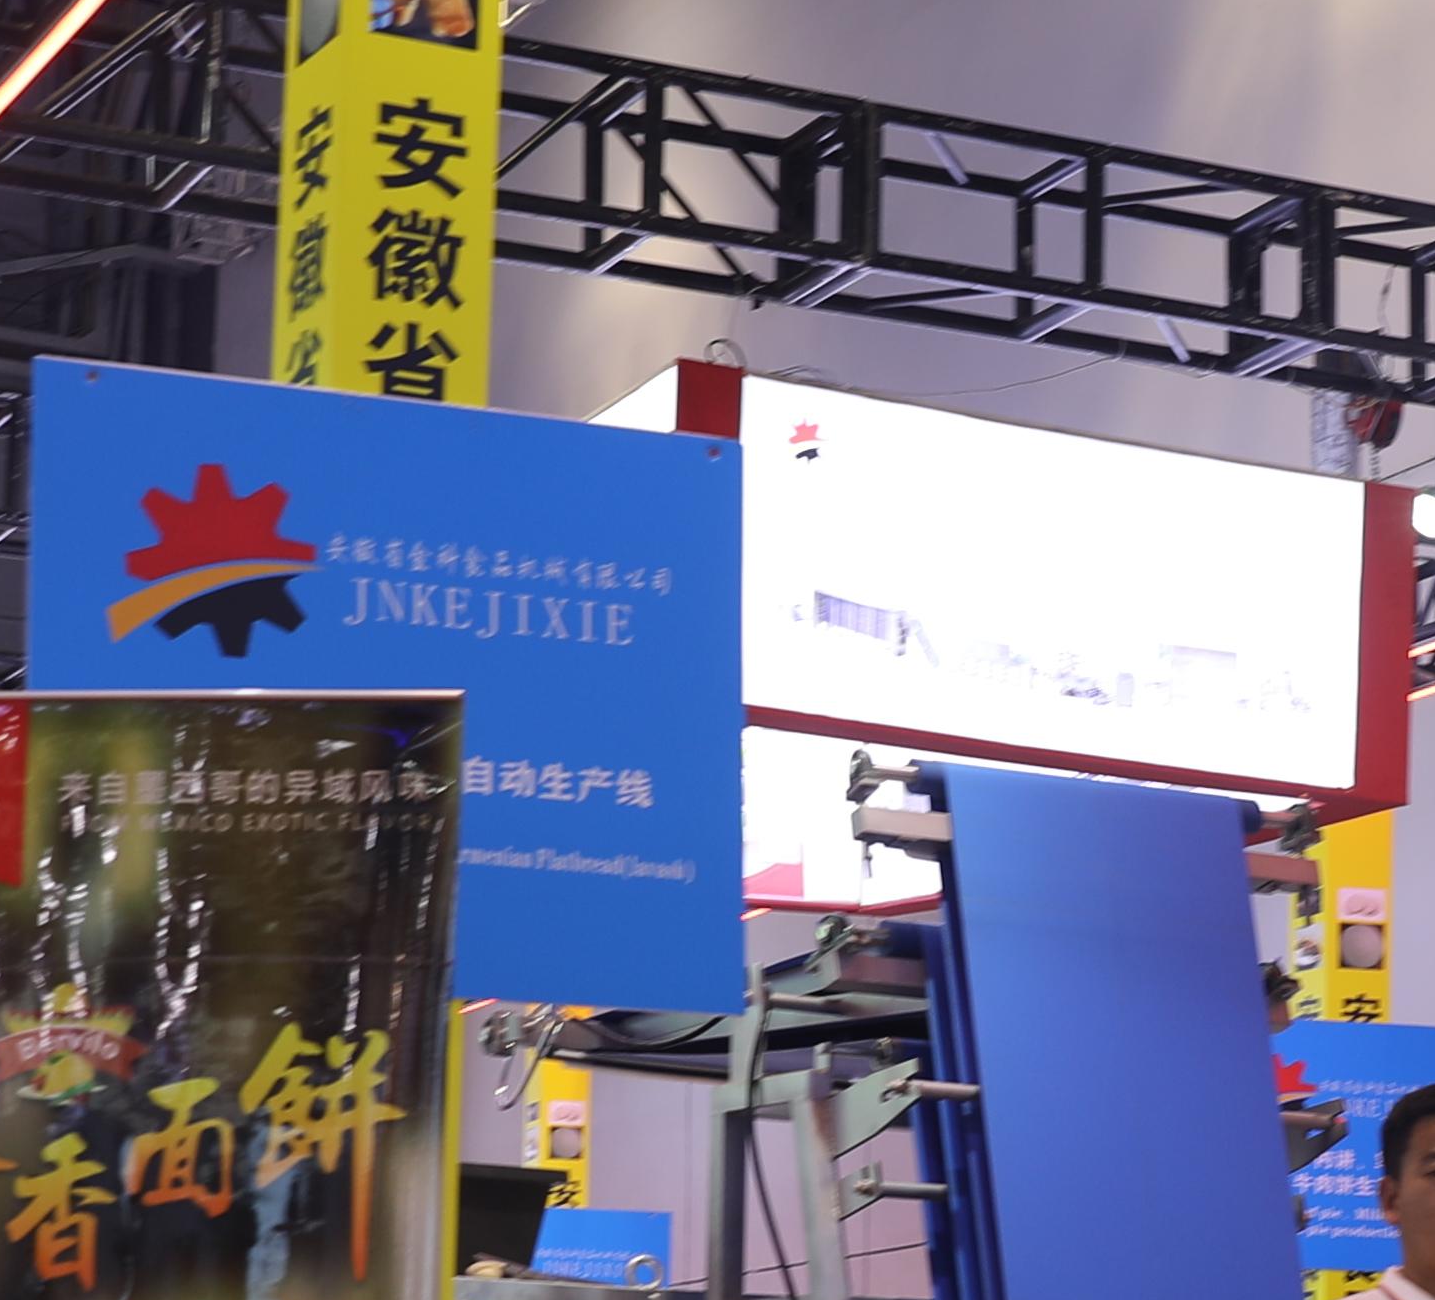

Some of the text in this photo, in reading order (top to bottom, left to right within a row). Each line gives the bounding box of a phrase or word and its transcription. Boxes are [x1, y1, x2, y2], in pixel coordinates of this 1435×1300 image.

[362, 97, 468, 401] 安徽省
[343, 577, 635, 645] JNKEJIXIE
[462, 755, 654, 809] 自动生产线
